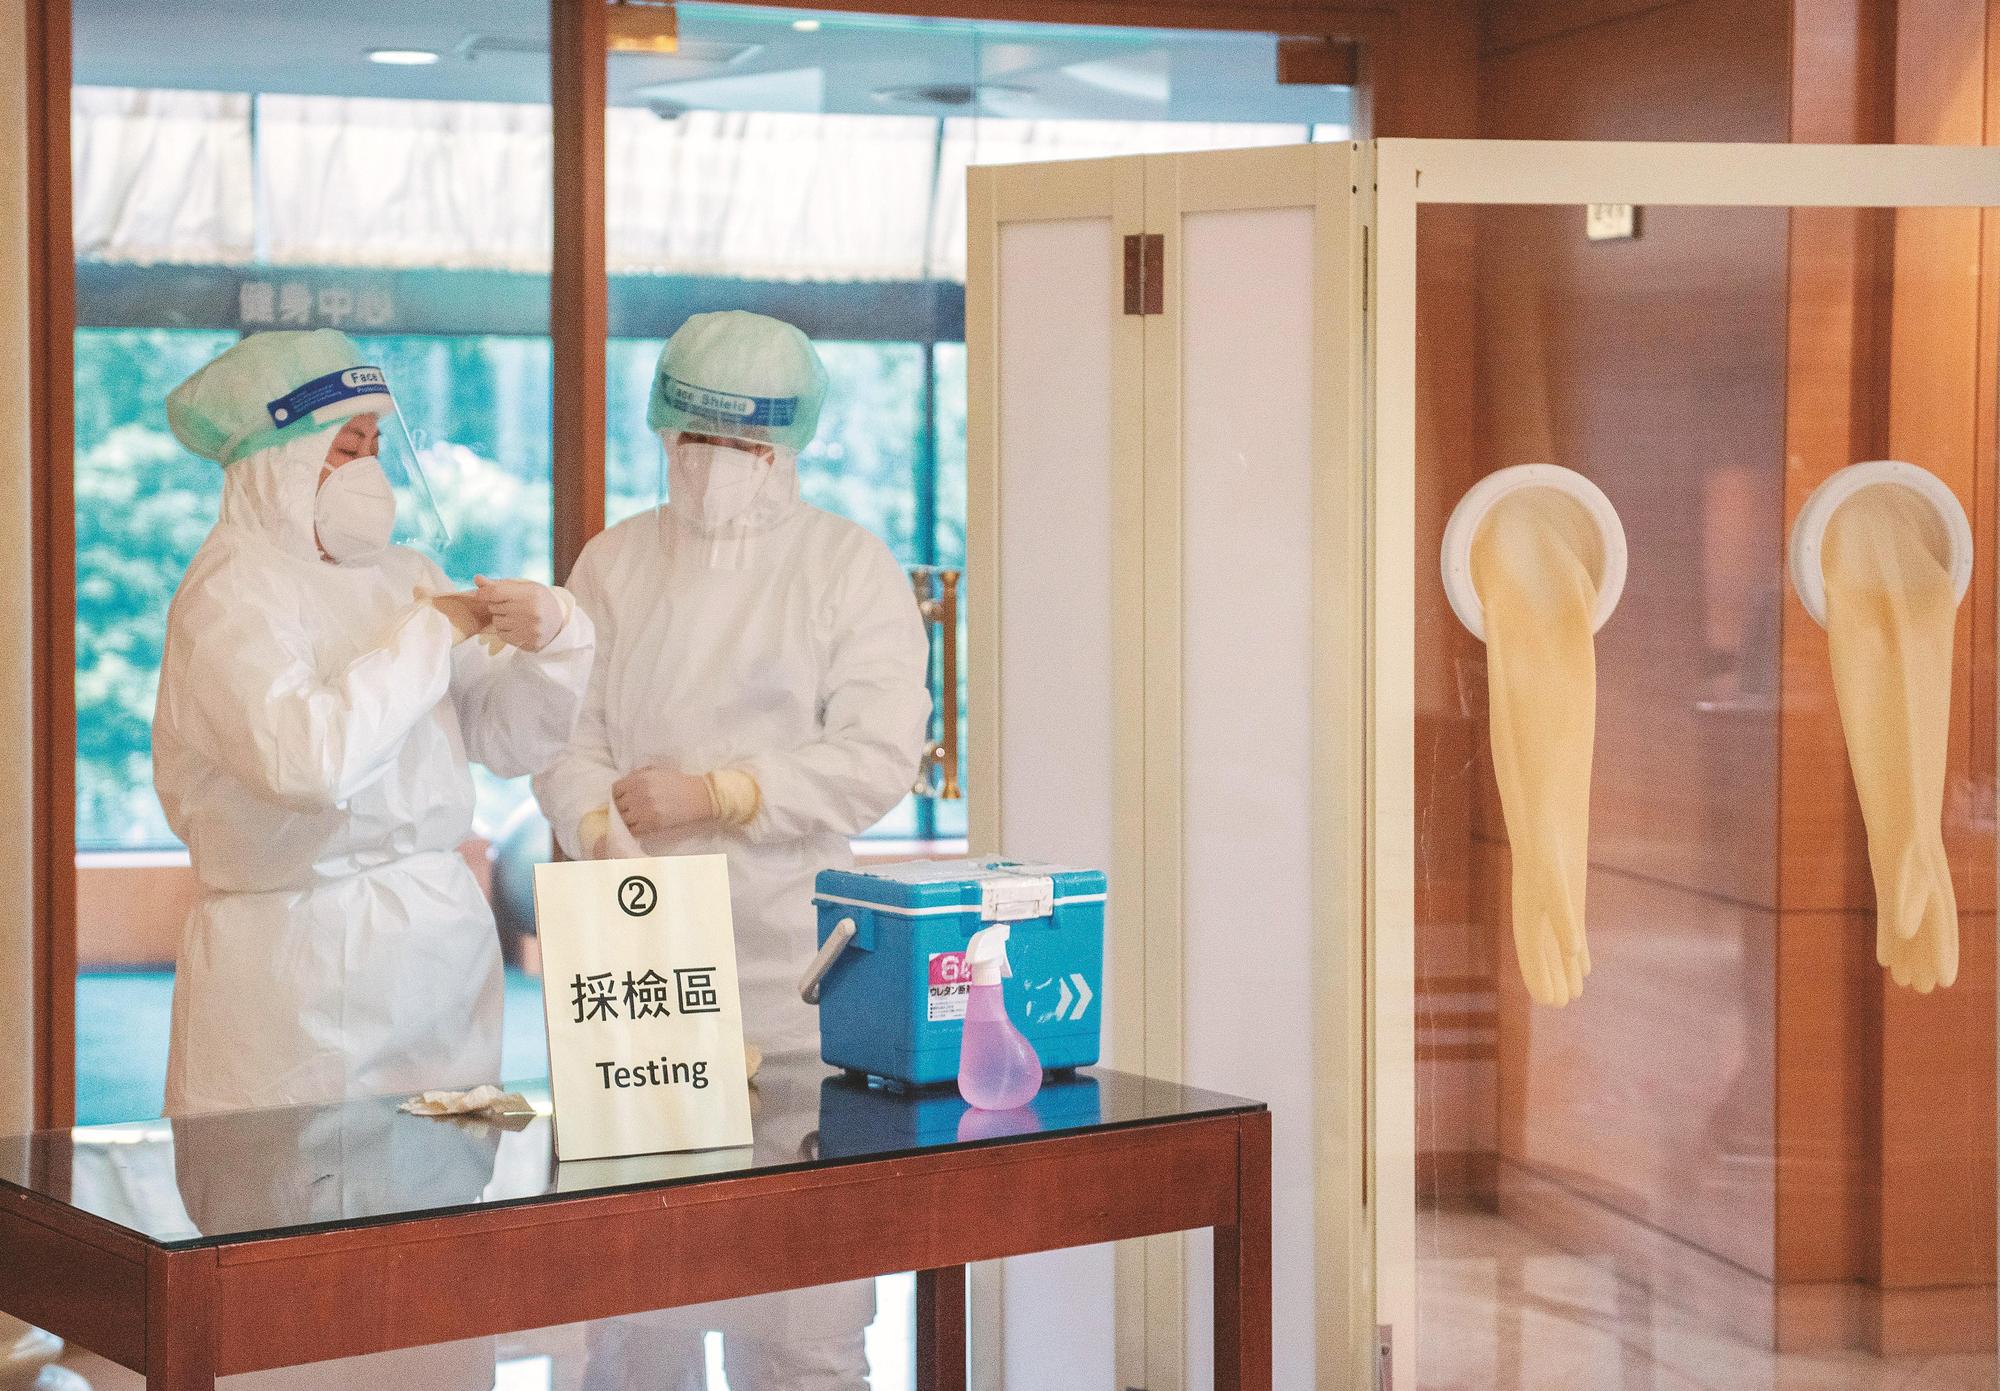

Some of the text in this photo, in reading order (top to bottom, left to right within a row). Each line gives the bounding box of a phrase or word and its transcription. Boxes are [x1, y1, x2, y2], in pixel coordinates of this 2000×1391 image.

[351, 372, 378, 384] Face
[702, 393, 748, 412] Shield
[570, 966, 721, 1024] 採檢區
[595, 1056, 709, 1090] Testing
